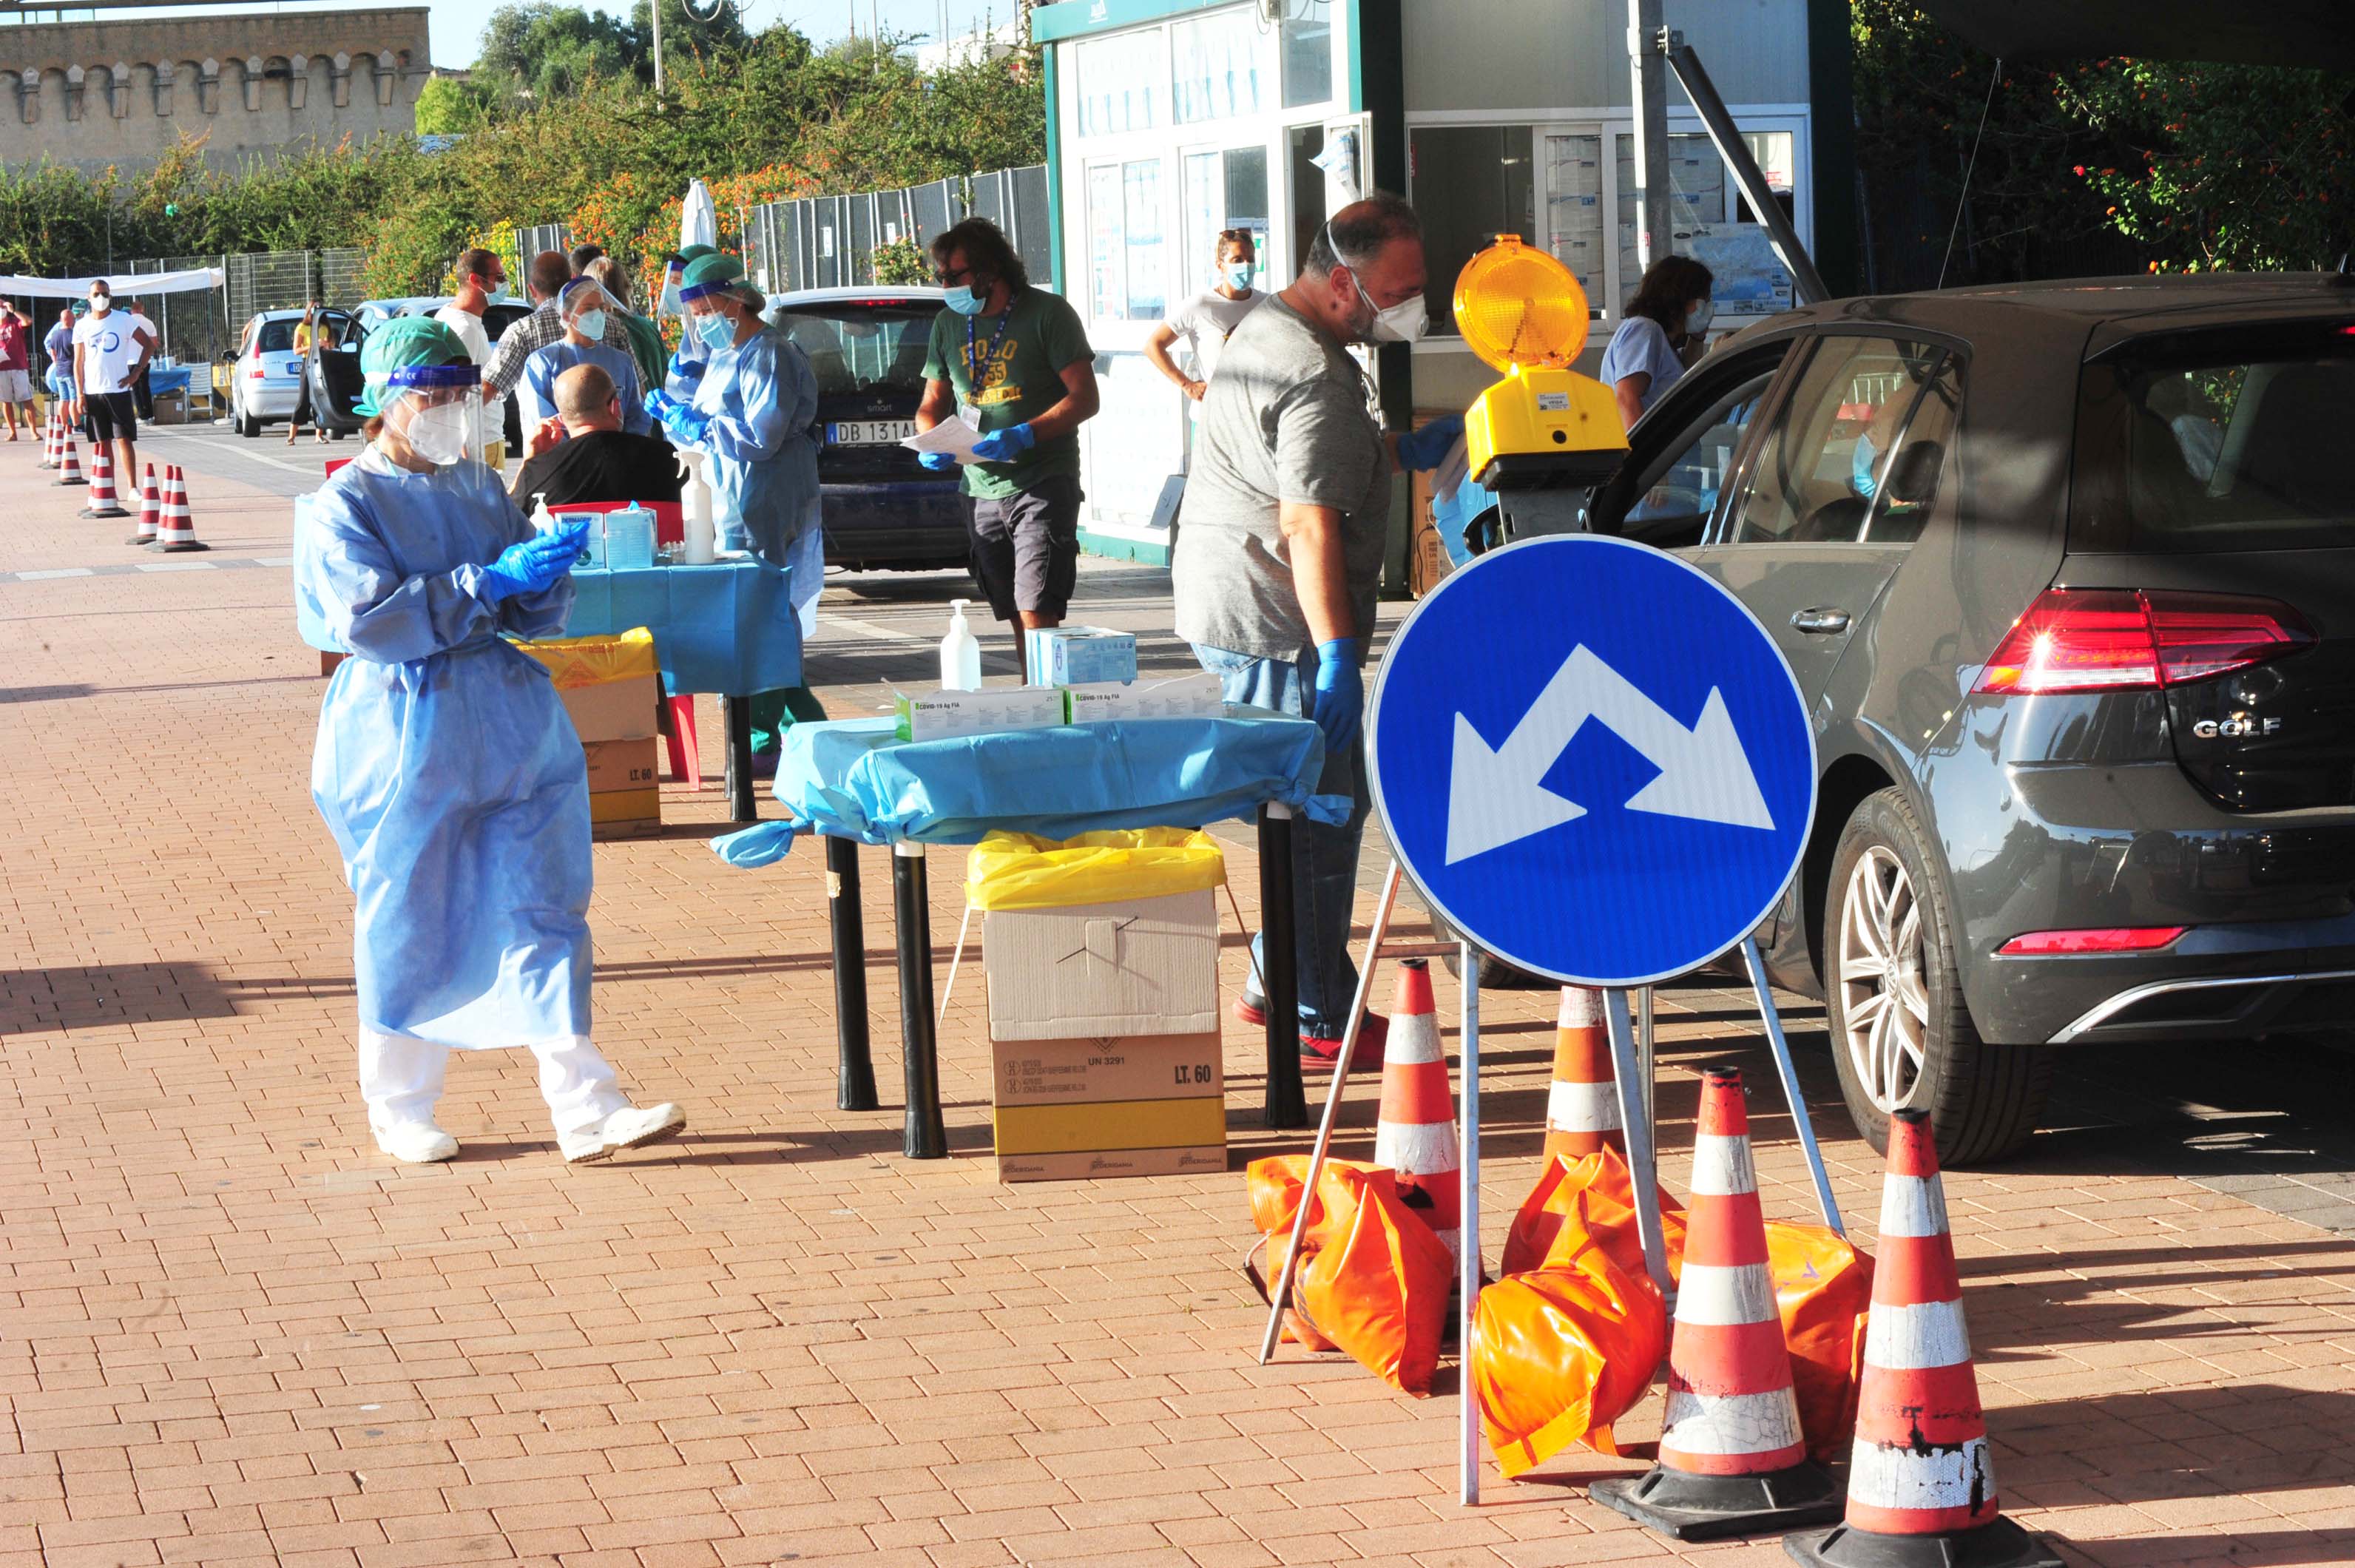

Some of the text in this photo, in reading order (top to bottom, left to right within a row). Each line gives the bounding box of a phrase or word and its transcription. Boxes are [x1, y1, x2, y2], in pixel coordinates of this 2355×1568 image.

[960, 339, 1018, 366] POO
[867, 403, 893, 412] smart
[839, 422, 916, 442] DB 131A
[2193, 717, 2281, 739] GOLF
[1088, 1056, 1125, 1066] UN 3291
[1175, 1064, 1212, 1084] LT. 60
